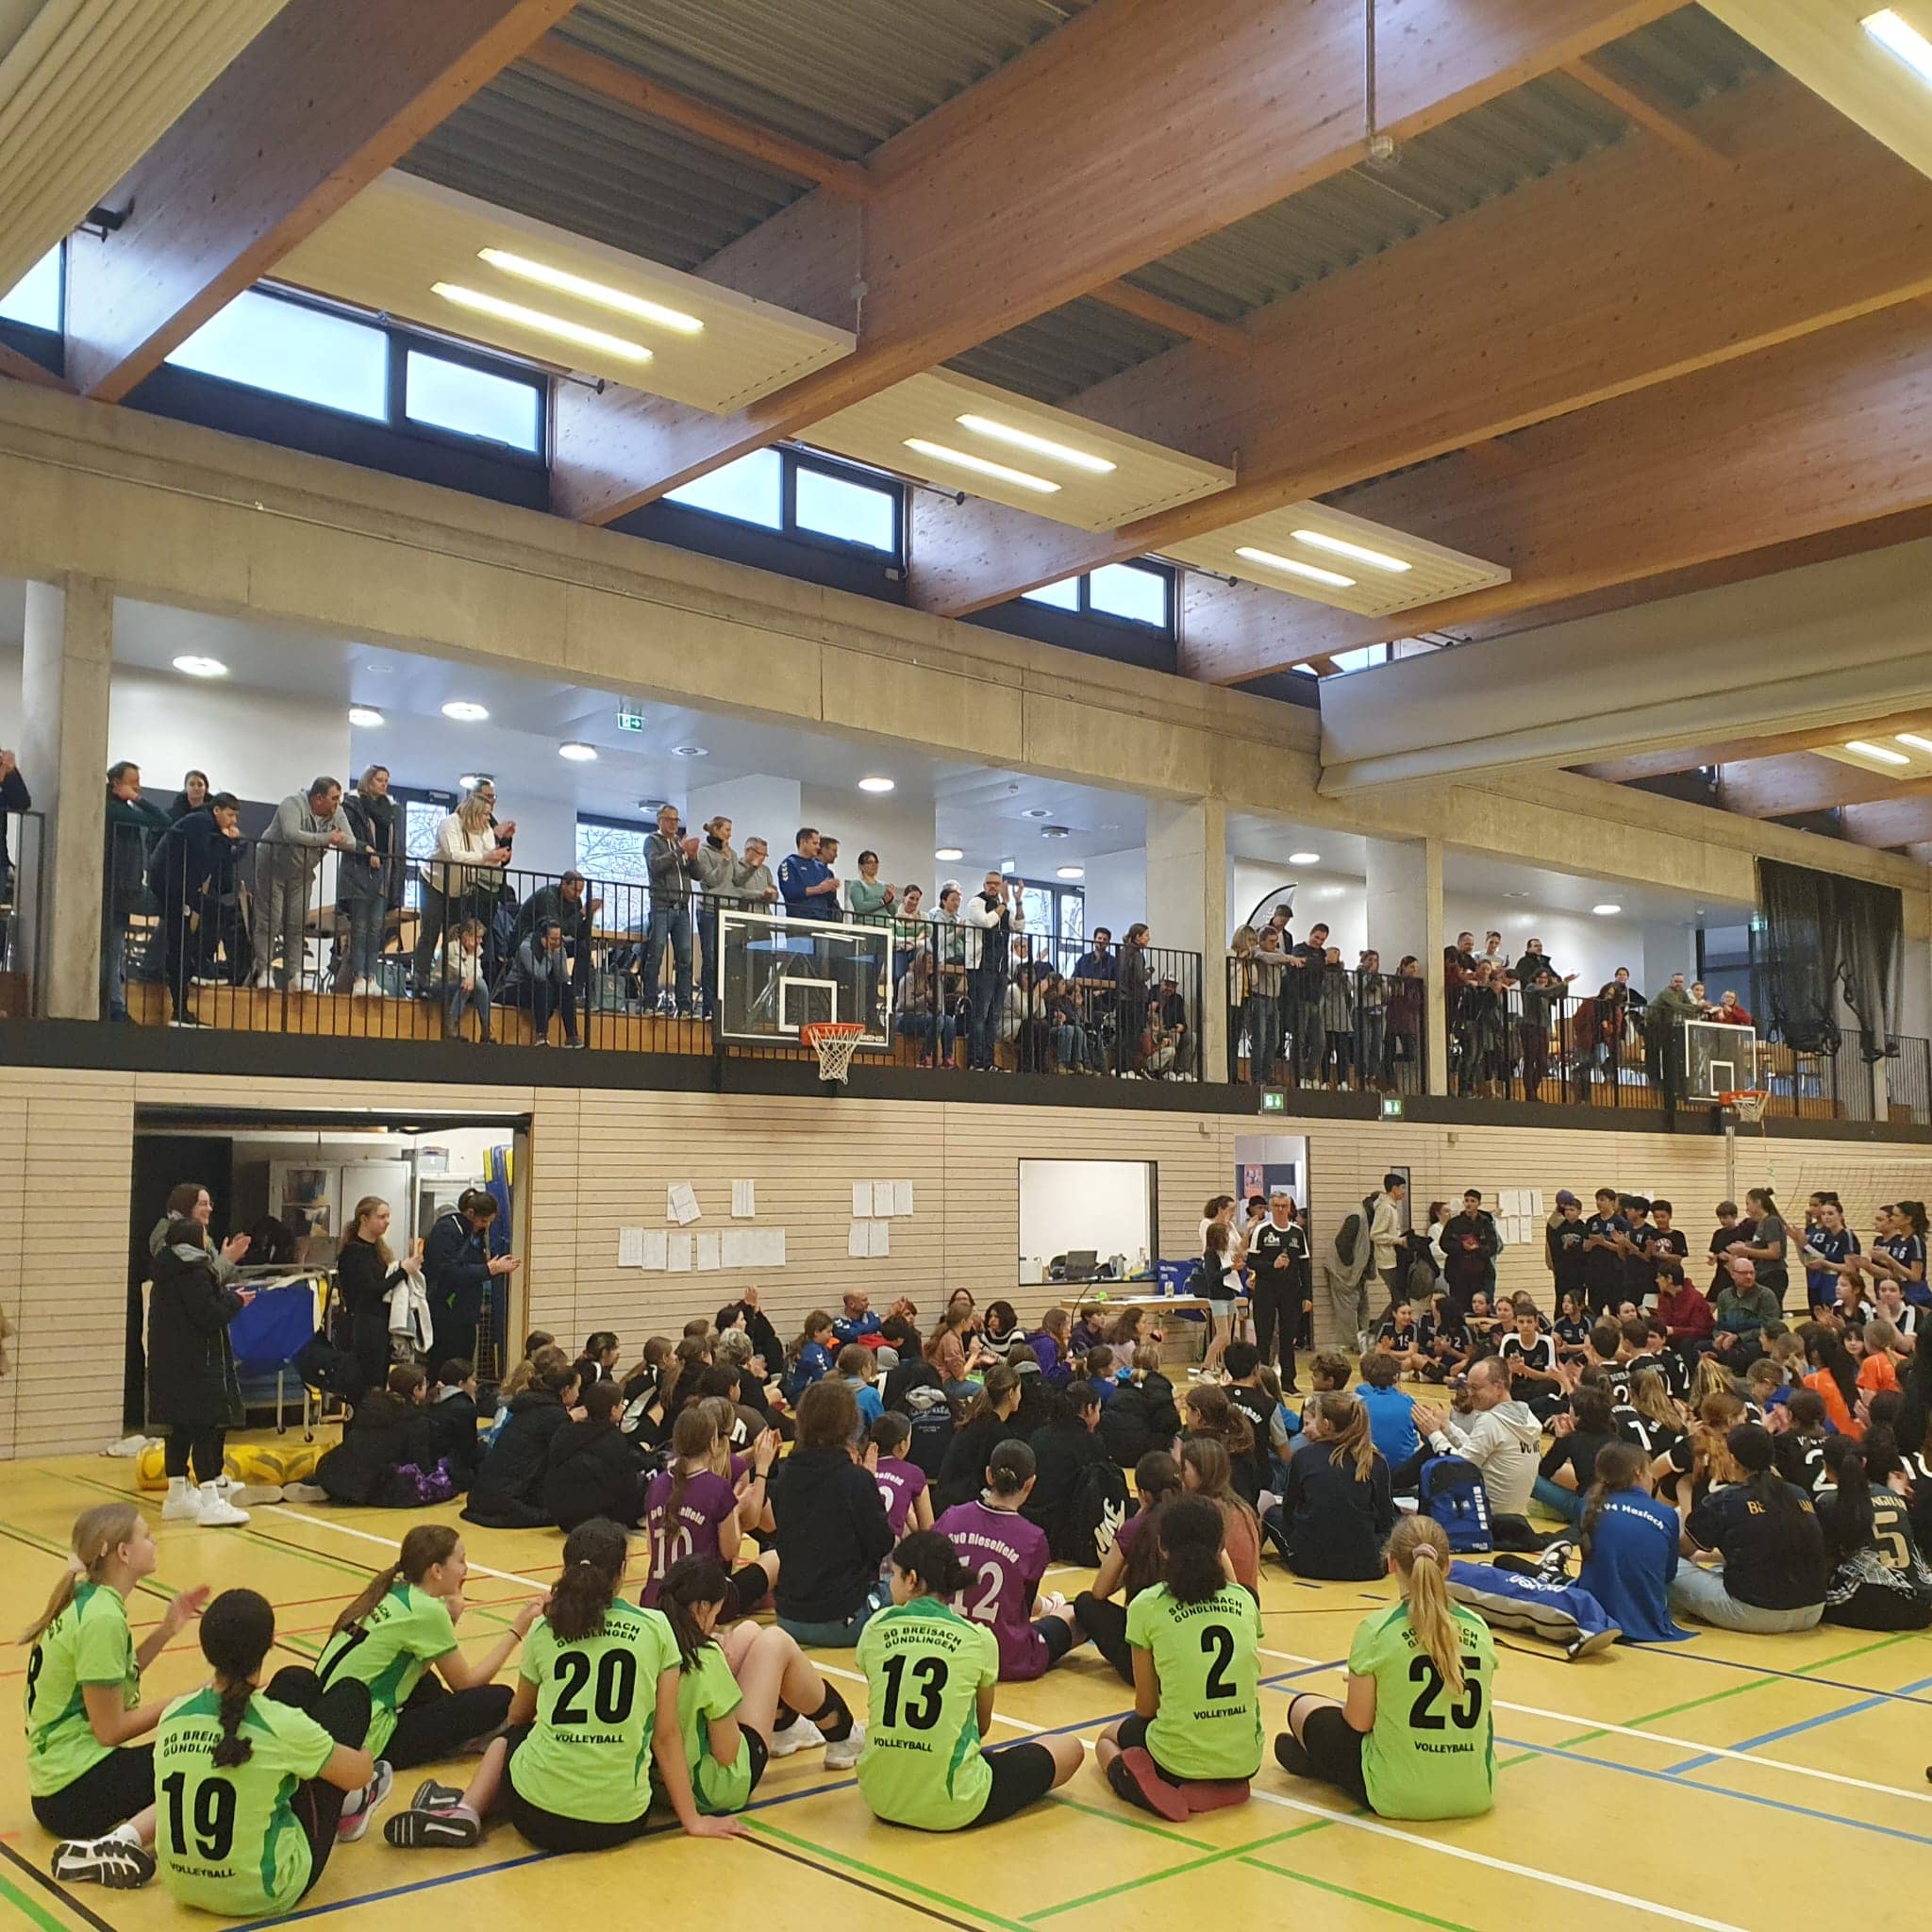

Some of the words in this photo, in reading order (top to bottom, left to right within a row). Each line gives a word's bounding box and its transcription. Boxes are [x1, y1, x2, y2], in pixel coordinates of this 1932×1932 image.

[968, 1532, 1020, 1564] Rieselfeld
[1872, 1511, 1910, 1569] 5
[948, 1556, 1004, 1624] 12
[902, 1626, 962, 1646] BREISACH
[1200, 1624, 1237, 1700] 2
[551, 1648, 638, 1725] 20
[882, 1654, 949, 1730] 13
[1408, 1654, 1482, 1730] 25
[1193, 1706, 1247, 1720] VOLLEYBALL
[183, 1730, 222, 1744] BREIS
[555, 1733, 625, 1744] VOLLEYBALL
[874, 1736, 933, 1752] VOLLEYBALL
[1414, 1740, 1474, 1753] VOLLEYBALL
[161, 1771, 237, 1861] 19
[170, 1860, 236, 1878] VOLLEYBALL
